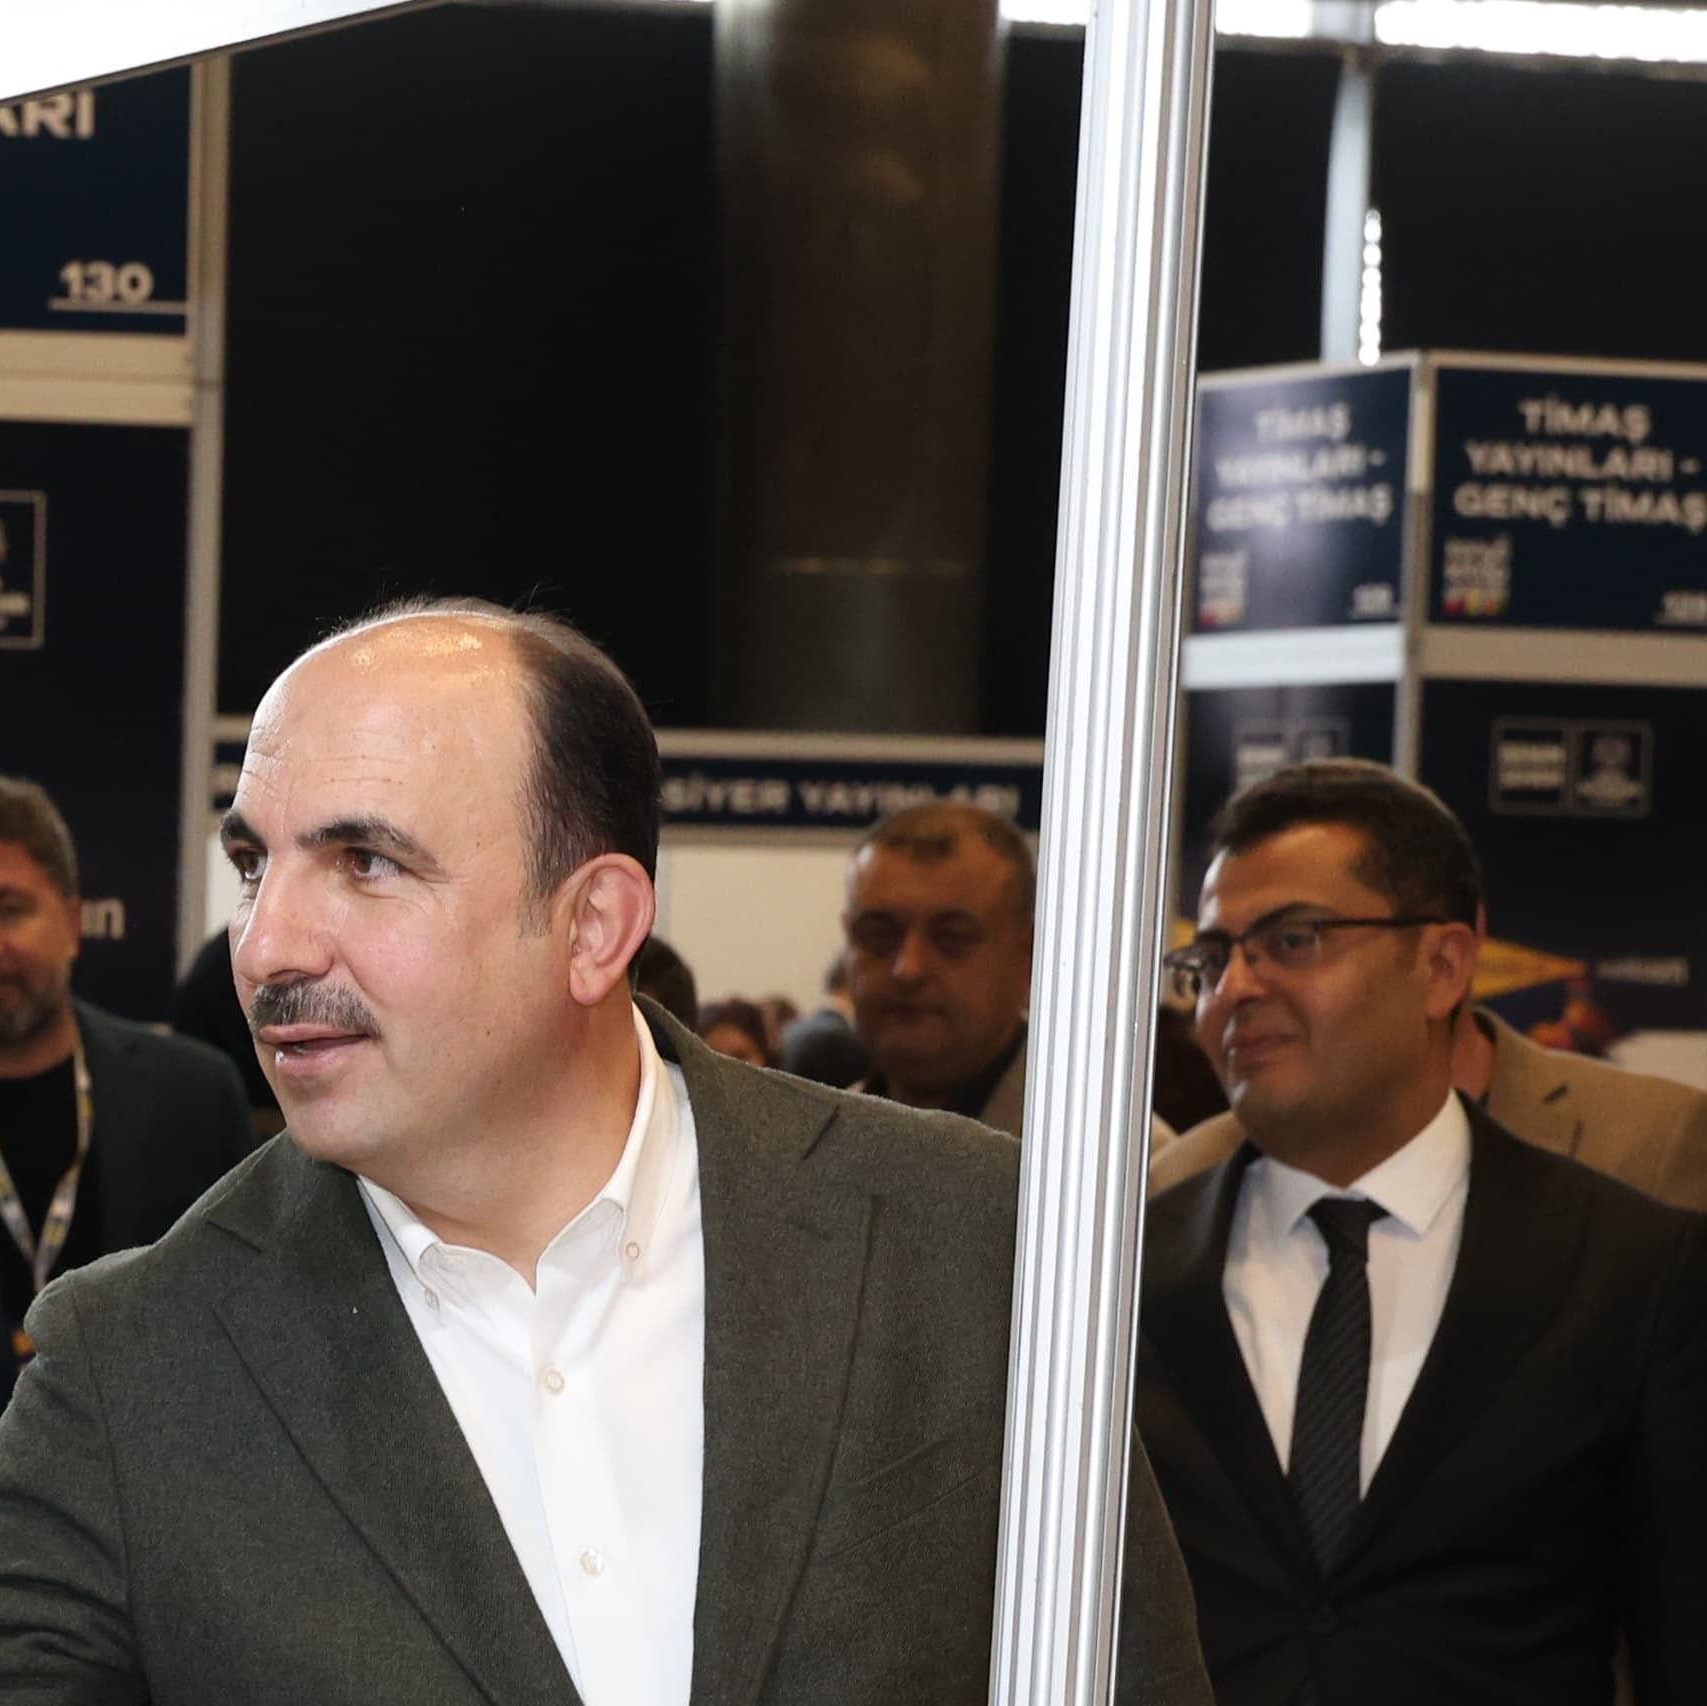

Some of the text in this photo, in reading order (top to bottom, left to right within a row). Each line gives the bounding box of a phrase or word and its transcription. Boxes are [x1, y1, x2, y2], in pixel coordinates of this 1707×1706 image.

[58, 262, 155, 302] 130
[1519, 397, 1651, 444] TİMAŞ
[1465, 441, 1664, 482] YAYINLARI
[1453, 485, 1571, 529] GENÇ
